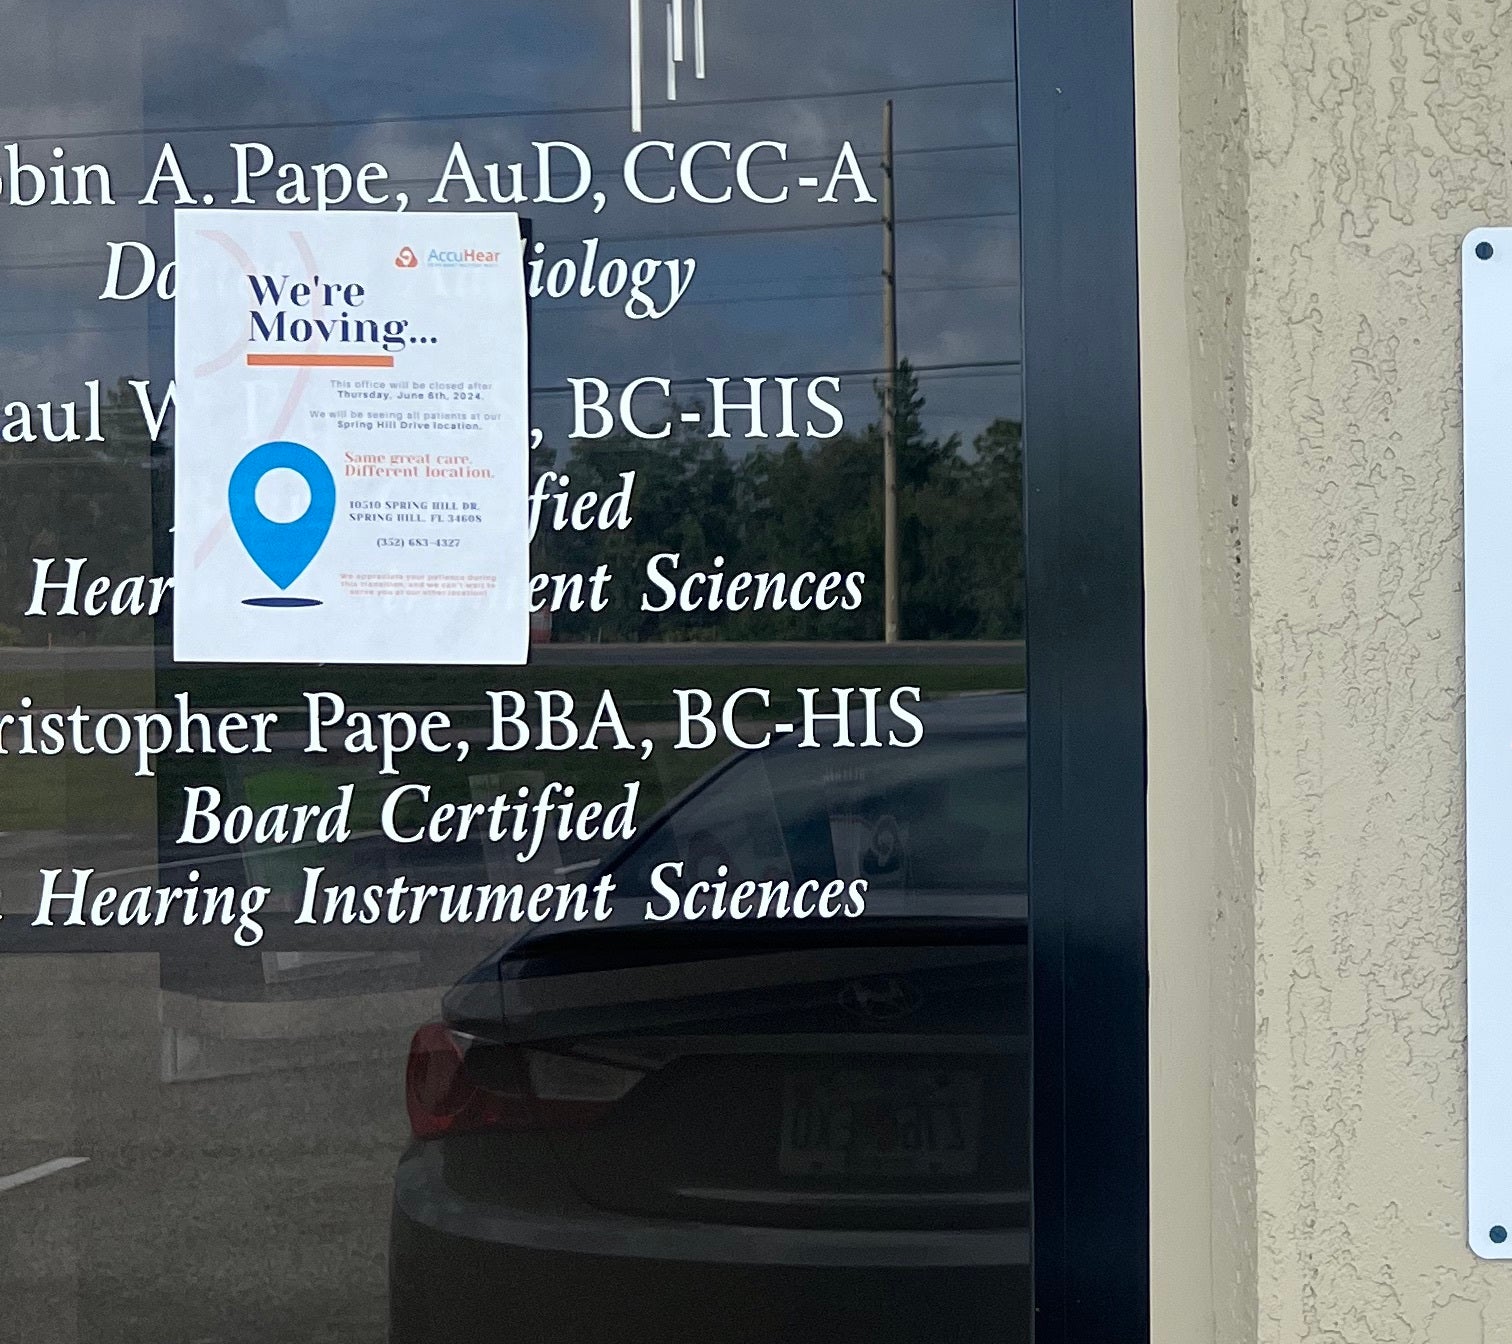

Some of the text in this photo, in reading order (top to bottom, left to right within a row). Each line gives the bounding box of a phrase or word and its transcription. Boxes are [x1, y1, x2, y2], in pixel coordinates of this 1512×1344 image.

[139, 143, 214, 205] A.
[230, 143, 408, 213] Pape,
[428, 142, 605, 214] AuD,
[624, 141, 877, 203] CCC-A
[428, 249, 500, 264] AccuHear
[526, 238, 695, 318] iology
[247, 275, 364, 307] We're
[248, 311, 437, 351] Moving...
[330, 380, 492, 390] This office will be closed after
[337, 391, 392, 400] Thursday,
[567, 377, 843, 438] BC-HIS
[309, 410, 325, 418] We
[329, 410, 347, 419] will
[350, 410, 363, 418] be
[367, 412, 401, 421] seeing
[406, 411, 419, 419] all
[424, 412, 468, 422] patients
[337, 420, 373, 430] Spring
[399, 421, 430, 429] Drive
[433, 422, 482, 430] location.
[344, 452, 473, 466] Same great care.
[345, 464, 496, 479] Different location.
[350, 501, 381, 509] 10510
[385, 501, 427, 509] SPRING
[432, 502, 458, 510] HILL
[349, 513, 392, 521] SPRING
[431, 514, 444, 522] FL
[377, 537, 460, 548] (352) 683-4327
[641, 553, 865, 611] Sciences
[303, 692, 468, 774] Pape,
[486, 690, 652, 760] BBA,
[673, 687, 923, 749] BC-HIS
[176, 781, 639, 862] Board Certified
[31, 869, 270, 946] Hearing
[295, 867, 616, 923] Instrument
[645, 862, 868, 920] Sciences
